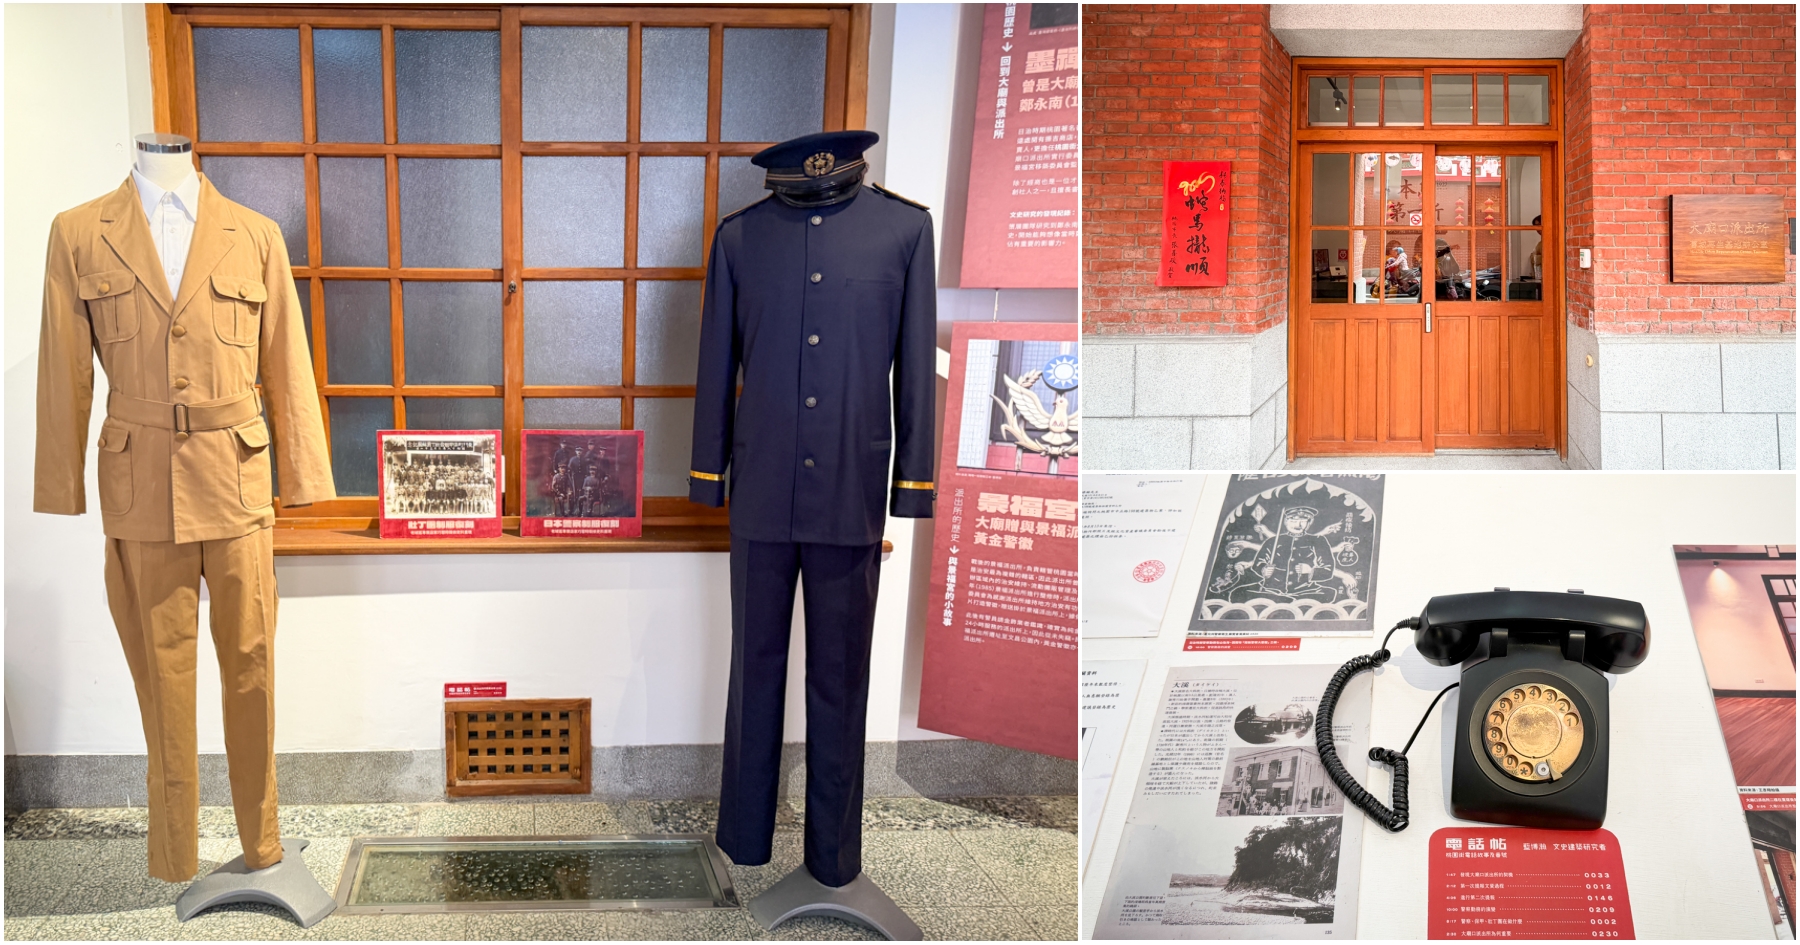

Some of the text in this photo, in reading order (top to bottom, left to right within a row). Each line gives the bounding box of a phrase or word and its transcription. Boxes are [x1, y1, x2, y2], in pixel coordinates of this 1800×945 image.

[1689, 221, 1770, 236] 大廟口派出所
[977, 492, 1078, 521] 景福宮
[973, 531, 1034, 551] 黃金警徽
[1513, 691, 1520, 700] 5
[1529, 688, 1535, 697] 4
[1546, 692, 1553, 700] 3
[1499, 701, 1506, 709] 6
[1559, 702, 1566, 711] 2
[1493, 714, 1499, 723] 7
[1567, 717, 1572, 726] 1
[1490, 730, 1497, 739] 8
[1495, 744, 1502, 753] 9
[1507, 757, 1514, 766] 0
[1445, 837, 1507, 851] 電話帖
[1553, 843, 1607, 851] 文史建築研究者
